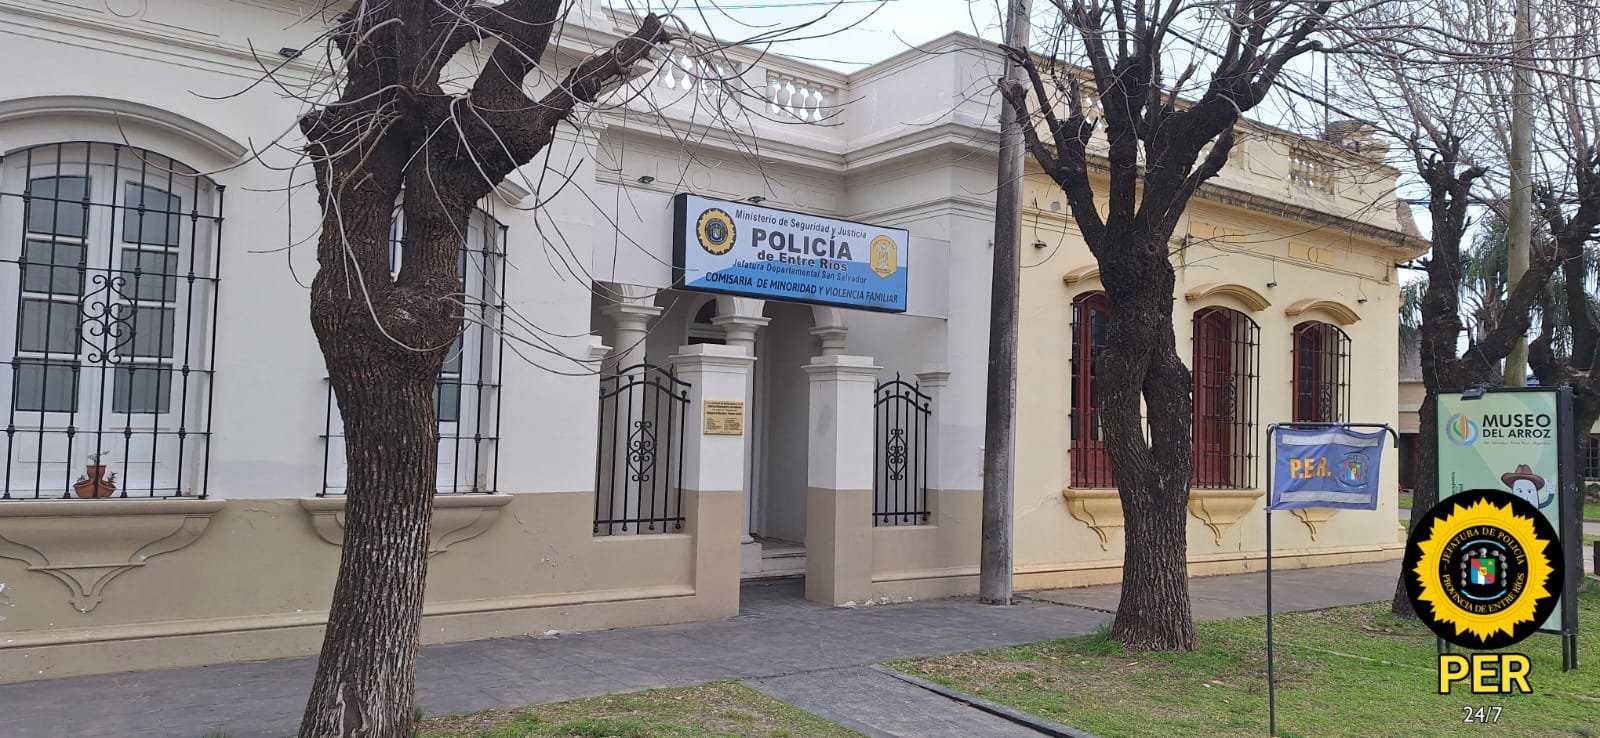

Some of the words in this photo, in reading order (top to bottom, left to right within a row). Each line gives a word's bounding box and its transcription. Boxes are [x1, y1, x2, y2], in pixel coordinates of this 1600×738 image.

[735, 209, 776, 225] Ministerio
[778, 217, 789, 227] de
[790, 218, 830, 233] Seguridad
[831, 227, 837, 235] y
[838, 226, 867, 239] Justicia
[751, 227, 853, 261] POLICÍA
[732, 258, 765, 271] Jefatura
[766, 263, 820, 278] Departamental
[821, 271, 835, 280] San
[836, 273, 867, 284] Salvador
[757, 250, 774, 262] de
[779, 252, 816, 267] Entre
[705, 271, 753, 287] COMISARIA
[757, 278, 768, 288] DE
[769, 280, 817, 295] MINORIDAD
[818, 285, 825, 295] Y
[825, 286, 865, 301] VIOLENCIA
[865, 291, 899, 304] FAMILIAR
[1482, 413, 1552, 428] MUSEO
[1482, 429, 1505, 438] DEL
[1508, 429, 1551, 439] ARROZ
